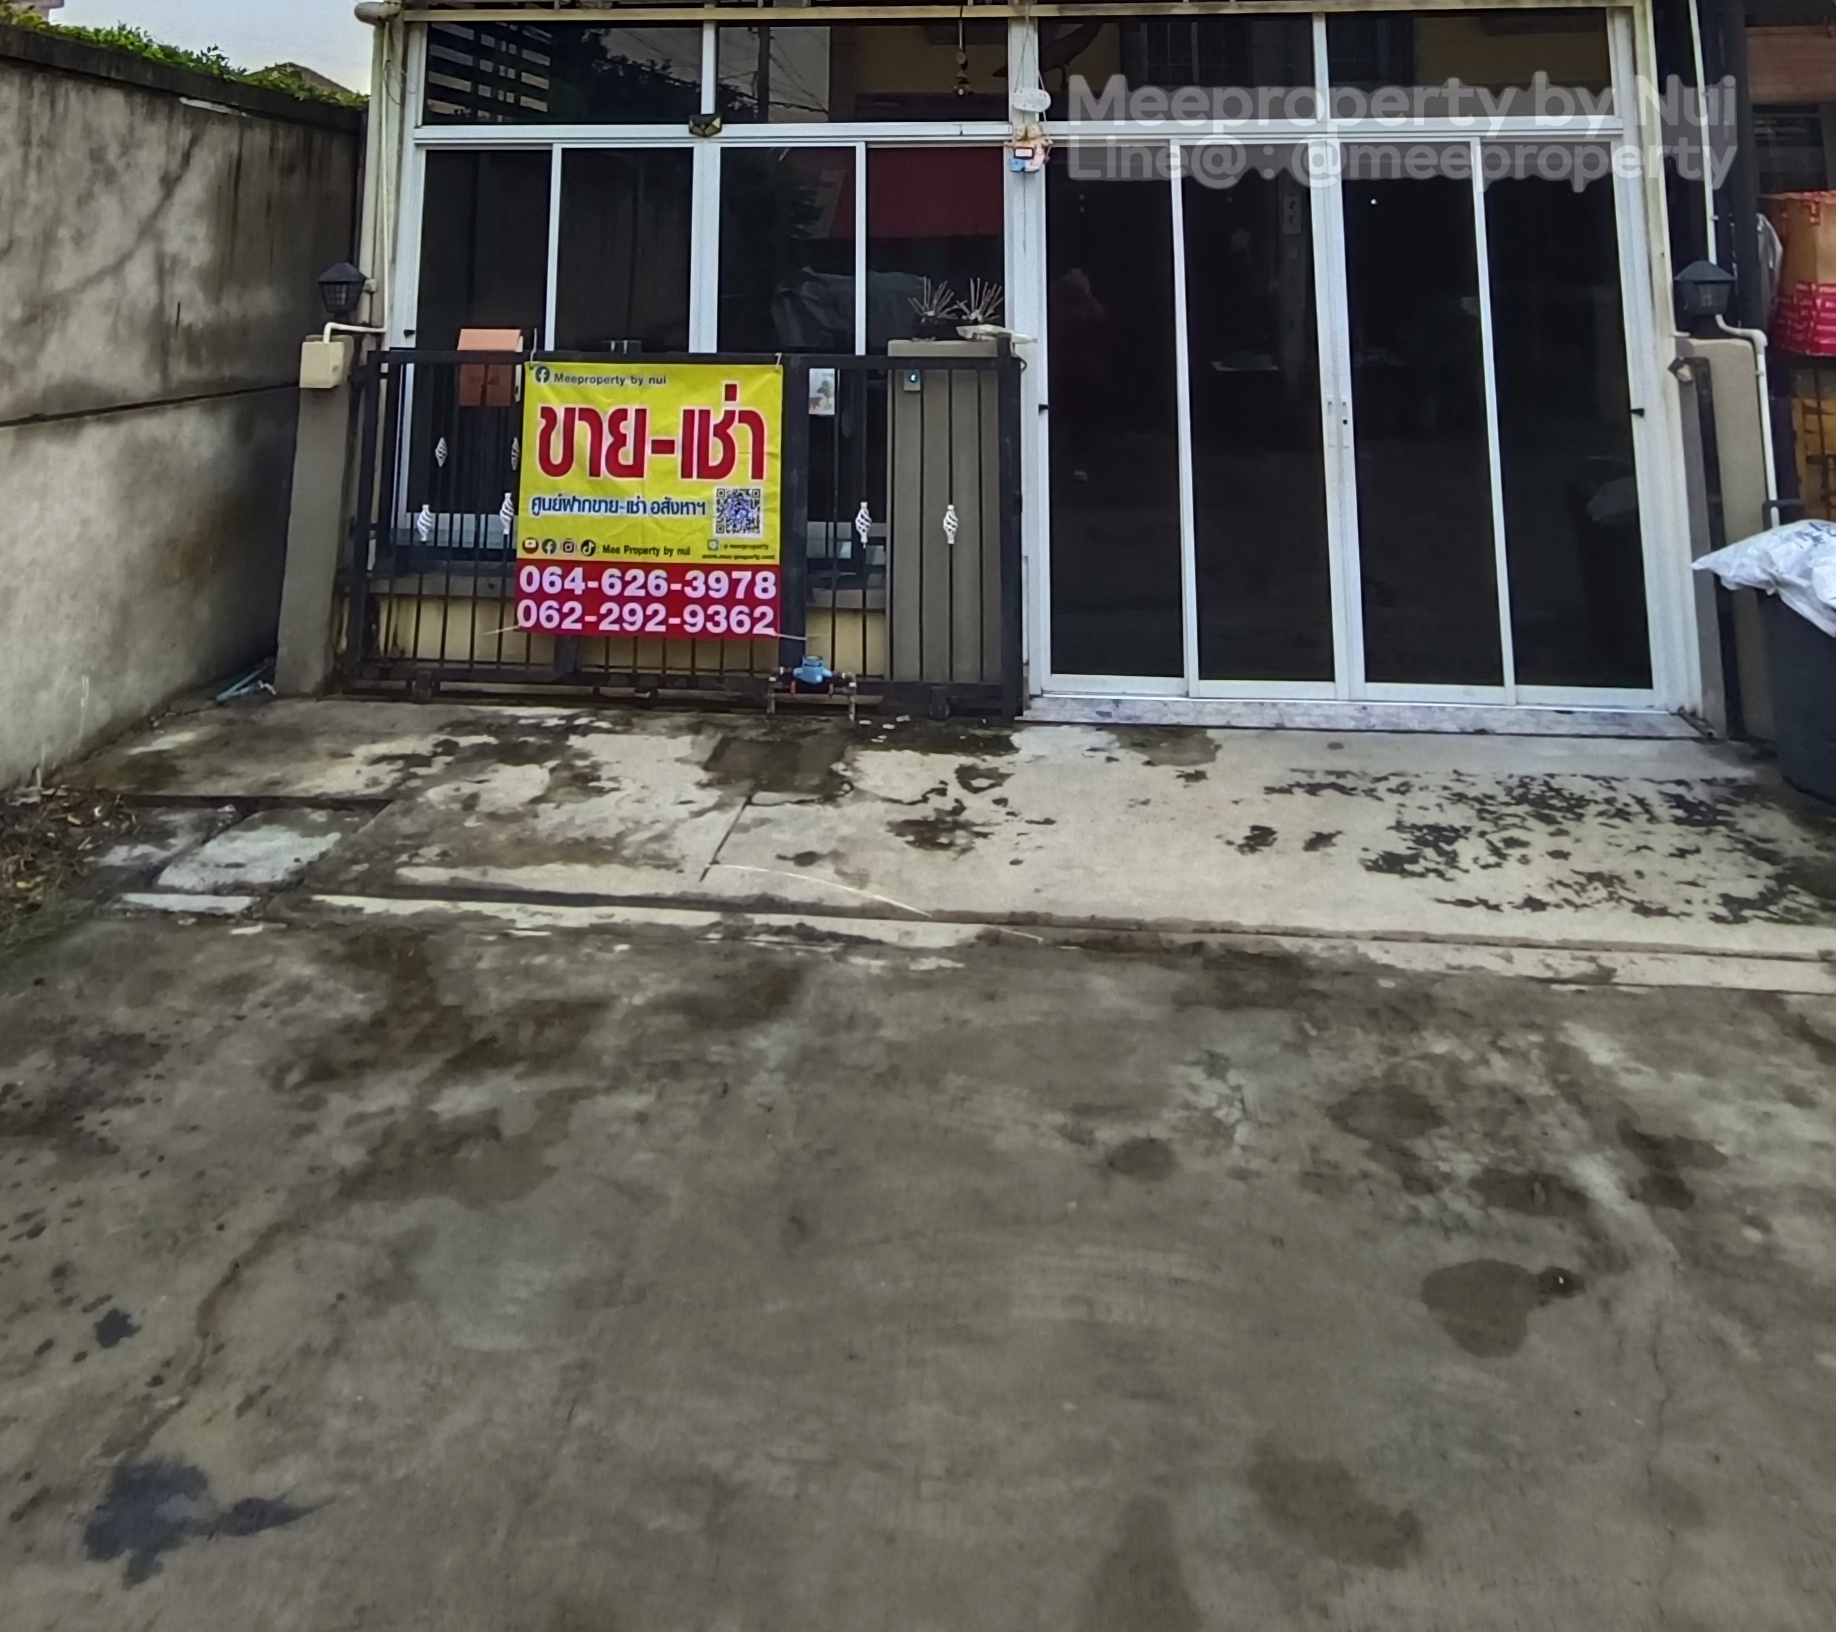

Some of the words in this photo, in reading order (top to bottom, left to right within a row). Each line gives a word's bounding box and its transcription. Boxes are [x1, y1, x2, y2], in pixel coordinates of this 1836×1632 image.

[553, 373, 625, 386] Meeproperty
[630, 370, 643, 385] by
[538, 382, 767, 481] ขาย-เช่า
[531, 493, 647, 516] ศูนย์ฝากขาย-เช่า
[651, 496, 706, 515] อสังหาฯ
[602, 544, 621, 555] Mee
[624, 545, 660, 556] Property
[663, 546, 674, 556] by
[519, 565, 777, 599] 064-626-3978
[517, 599, 776, 635] 062-292-9362
